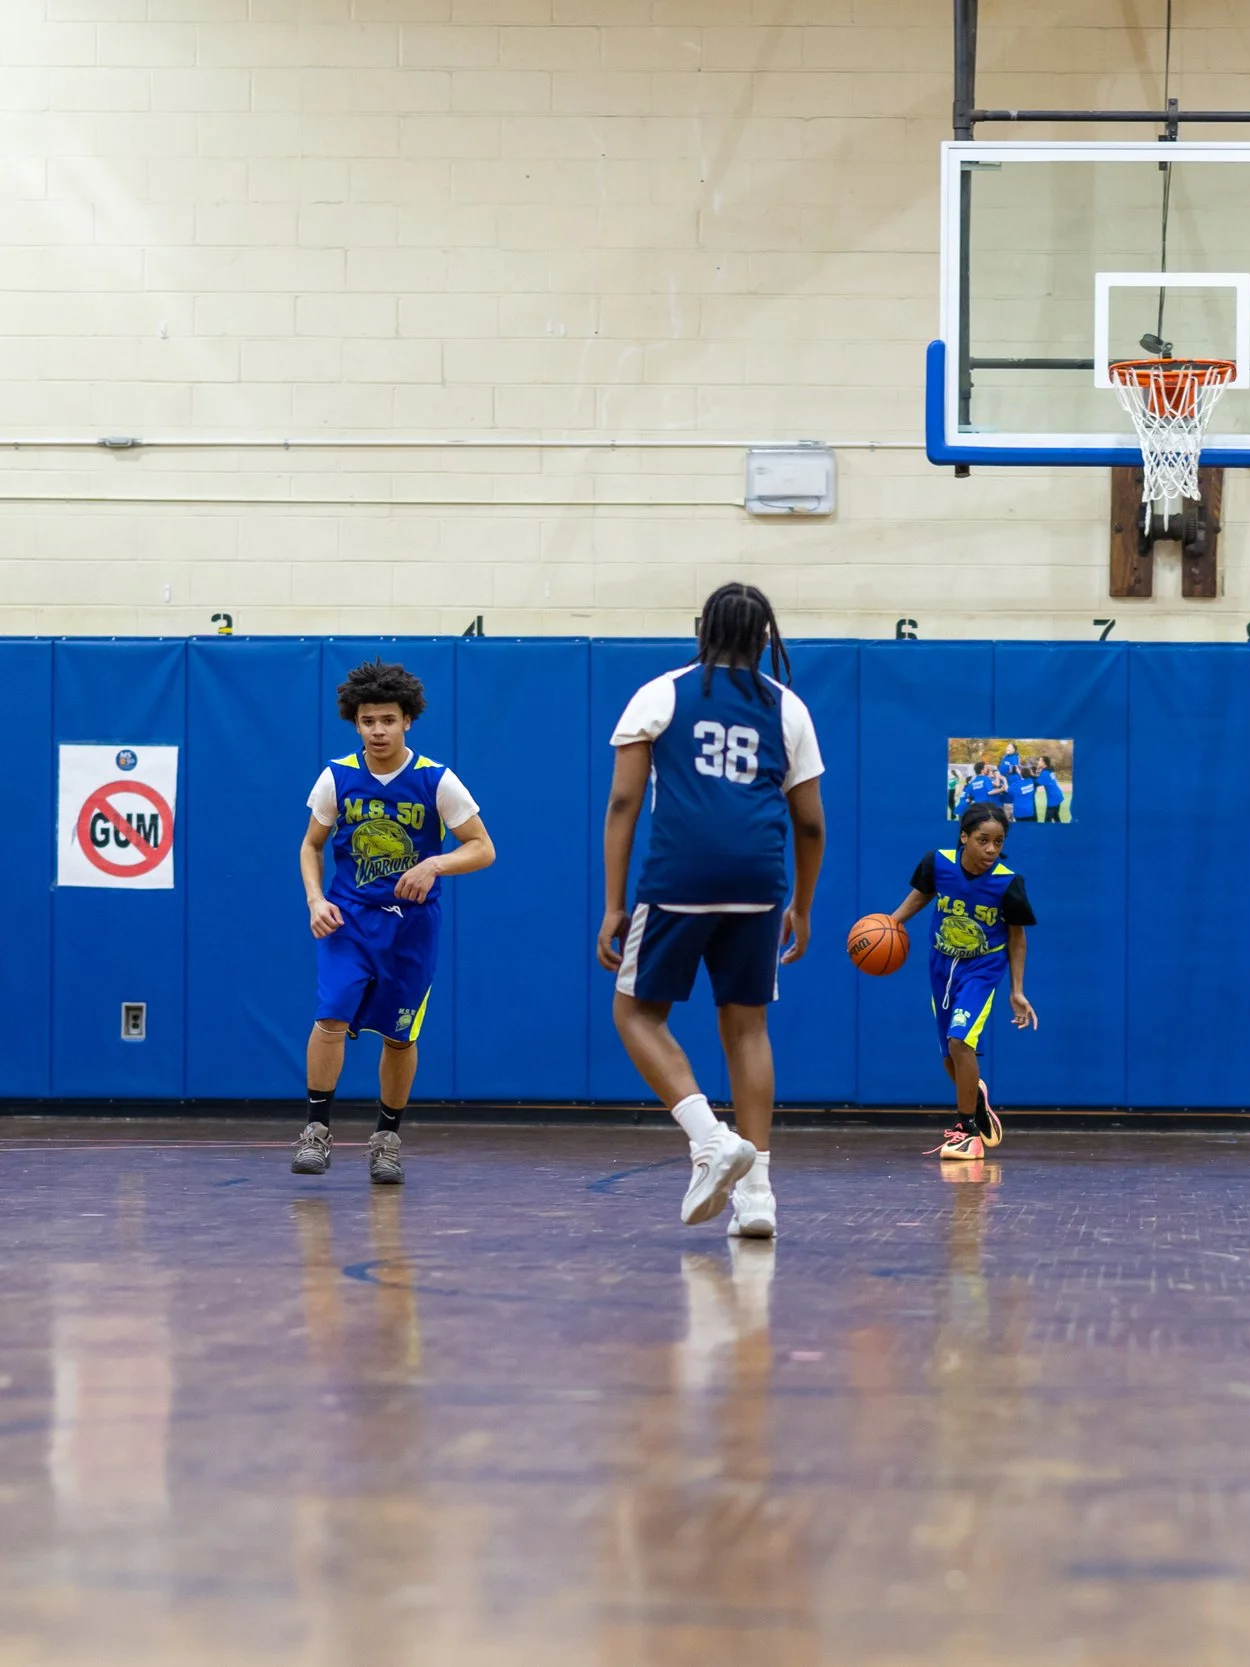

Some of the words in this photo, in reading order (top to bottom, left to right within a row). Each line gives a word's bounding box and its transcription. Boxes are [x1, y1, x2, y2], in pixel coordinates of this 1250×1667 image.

[462, 615, 486, 637] 4
[895, 618, 918, 640] 6
[1093, 619, 1116, 641] 7
[693, 720, 760, 785] 38
[344, 797, 390, 824] M.S.
[397, 801, 425, 830] 50
[90, 812, 160, 848] GUM
